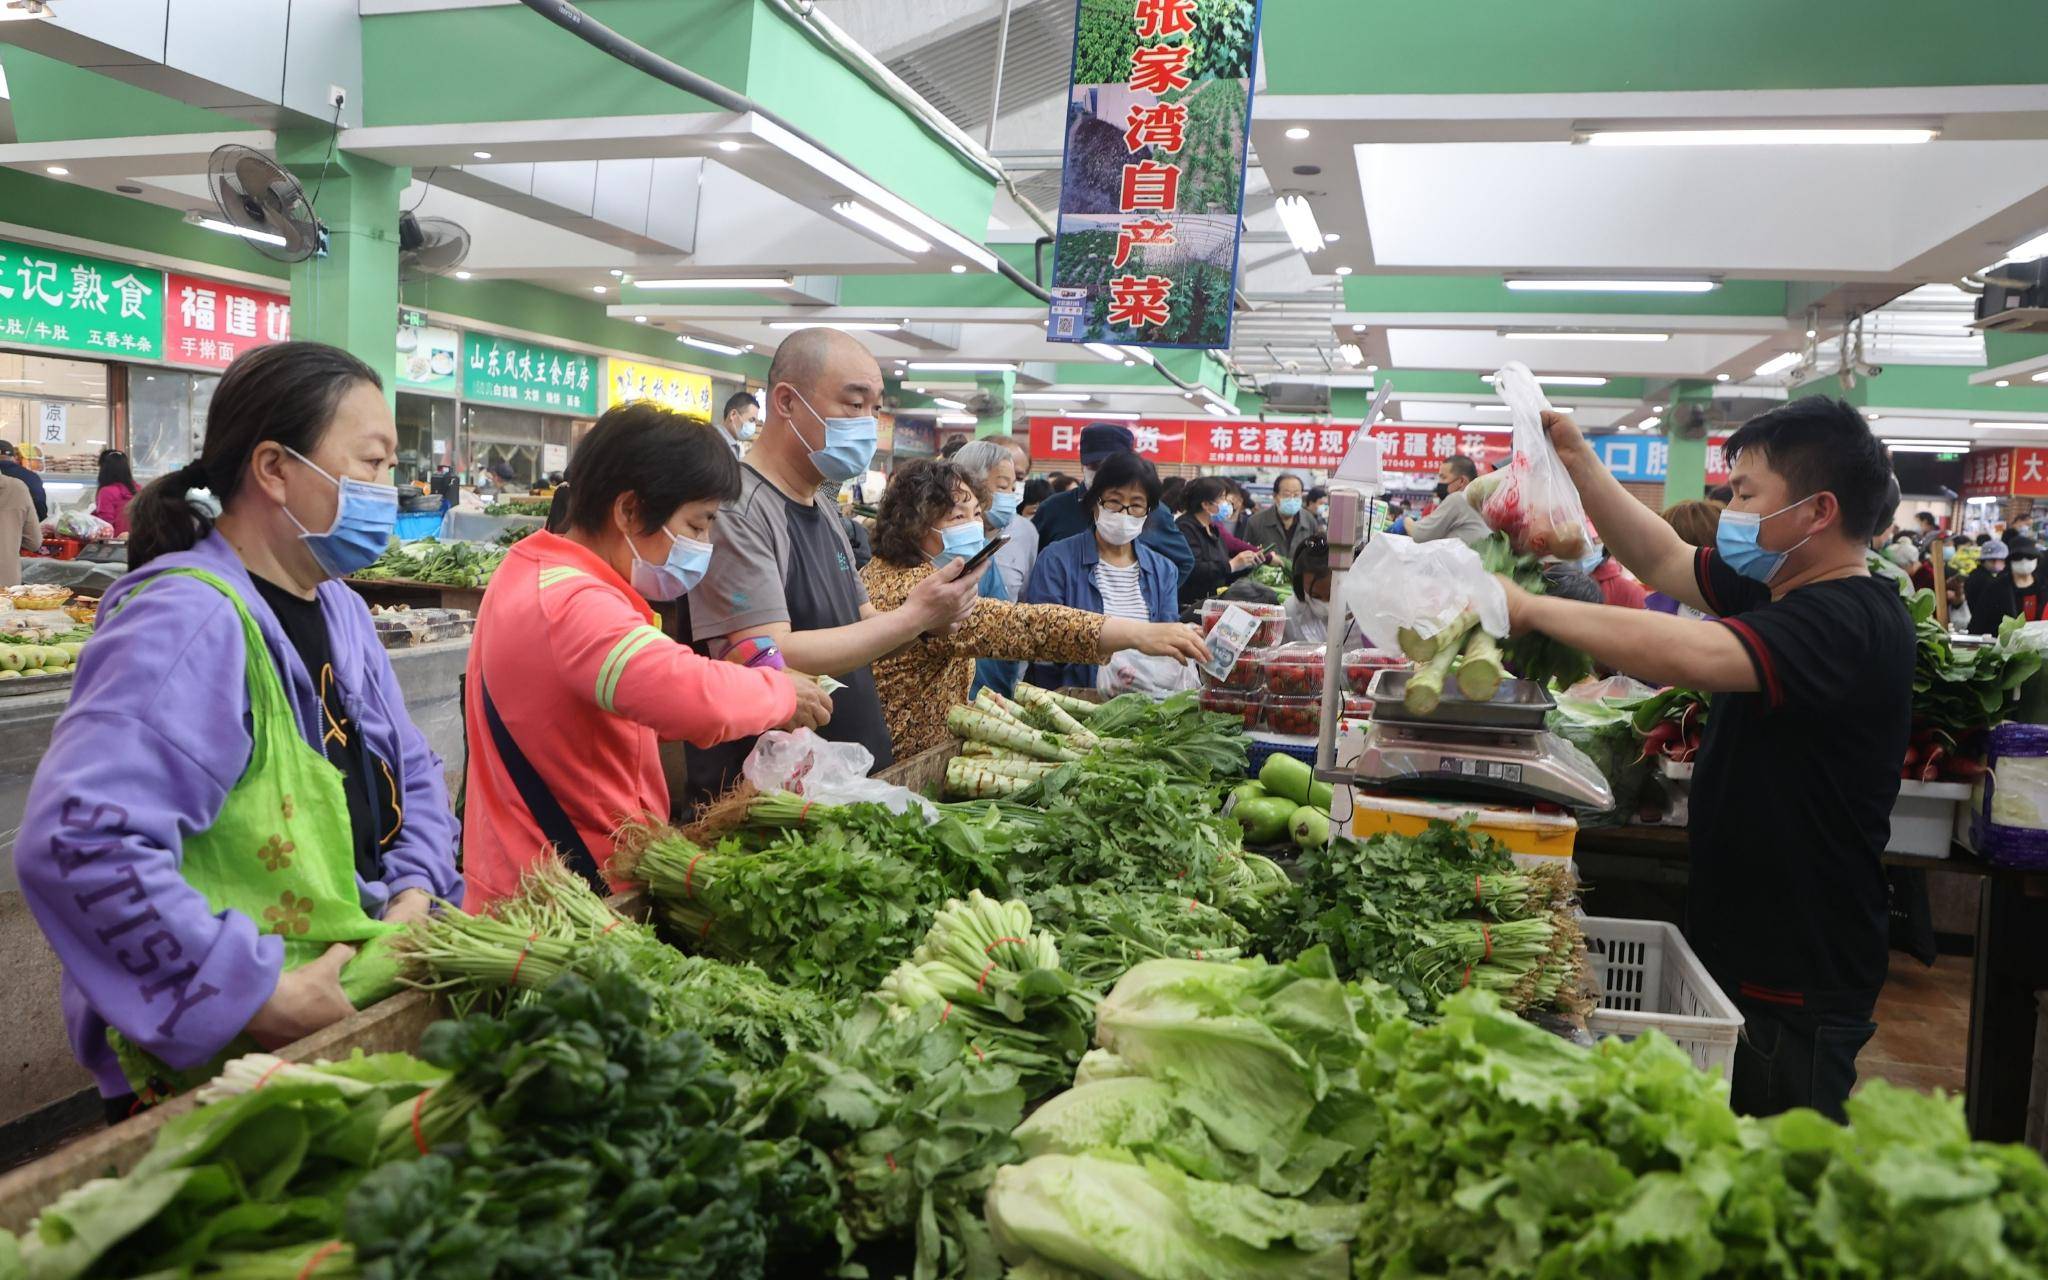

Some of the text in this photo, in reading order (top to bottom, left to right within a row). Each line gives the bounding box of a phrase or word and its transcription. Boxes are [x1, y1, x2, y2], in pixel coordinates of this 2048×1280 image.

[1107, 0, 1197, 328] 张家湾自产菜
[180, 338, 235, 363] 手擀面
[471, 342, 590, 391] 山东风味主食厨房
[1586, 440, 1668, 475] 口腔
[2022, 452, 2048, 481] 大
